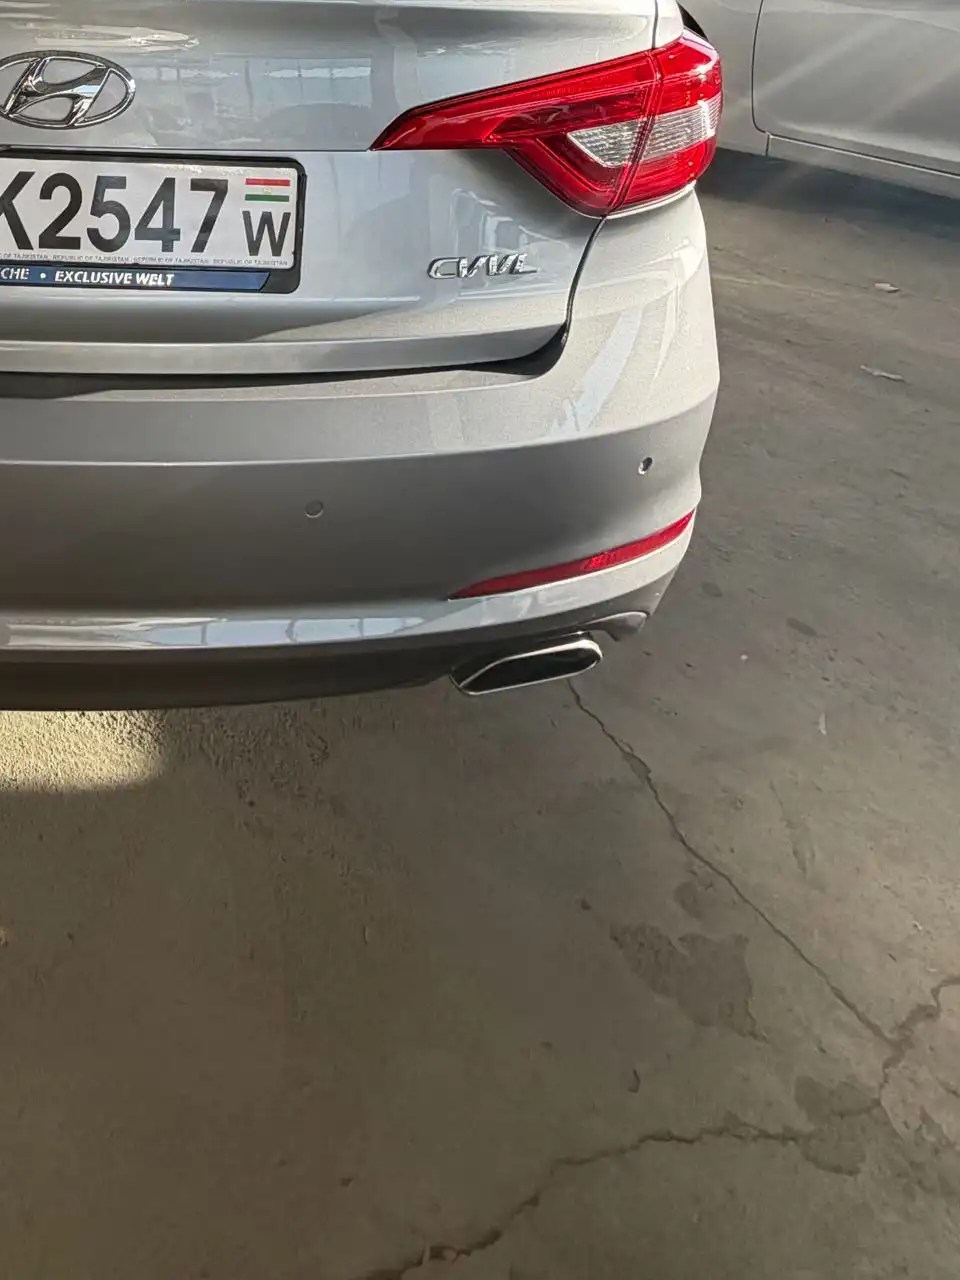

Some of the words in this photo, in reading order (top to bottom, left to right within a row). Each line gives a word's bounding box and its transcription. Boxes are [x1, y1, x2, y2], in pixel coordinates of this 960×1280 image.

[241, 210, 292, 258] W
[54, 270, 133, 285] EXCLUSIVE
[135, 272, 175, 286] WELT
